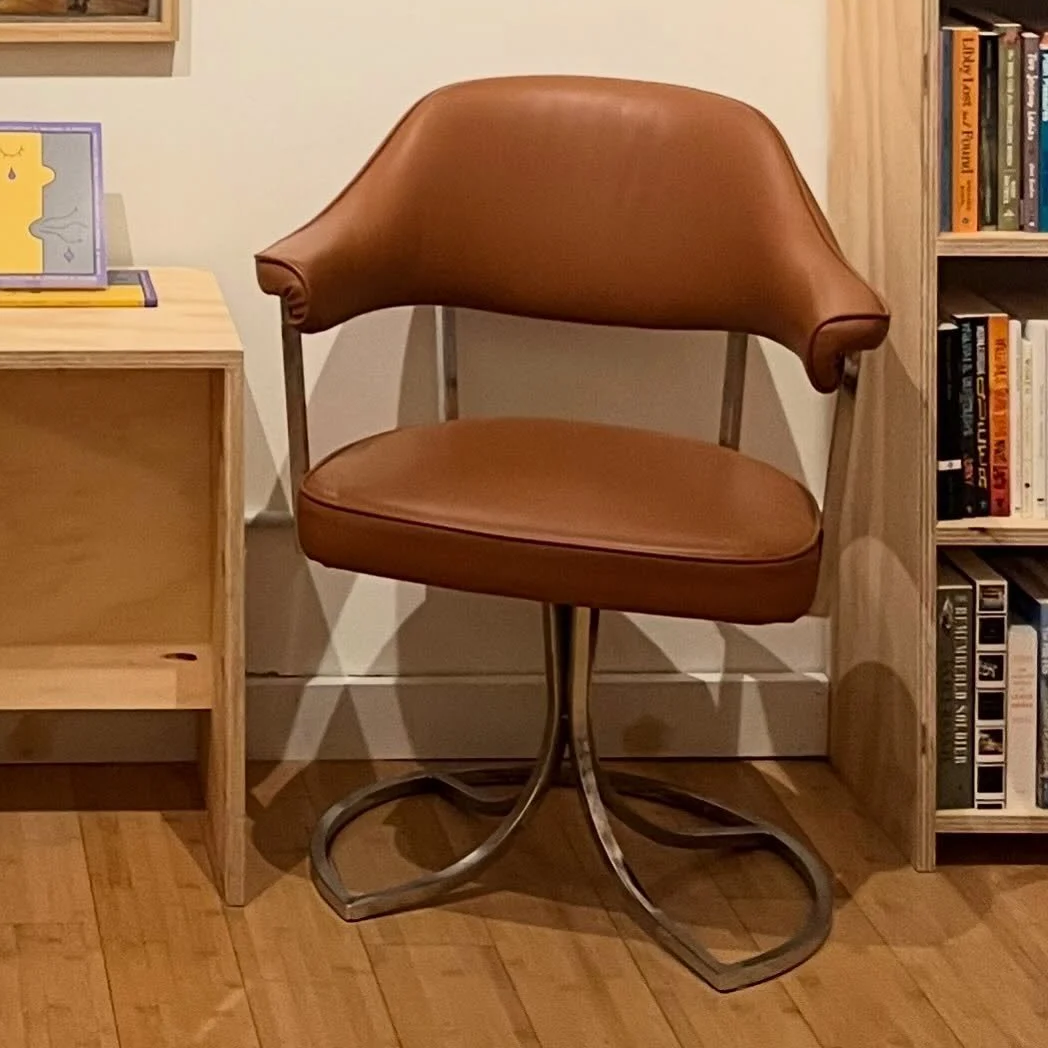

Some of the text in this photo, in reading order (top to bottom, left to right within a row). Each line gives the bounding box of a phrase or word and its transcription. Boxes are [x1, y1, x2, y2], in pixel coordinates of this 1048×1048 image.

[959, 38, 975, 174] Libby Lost Found
[954, 607, 968, 765] REMEMBERED SOLDIER
